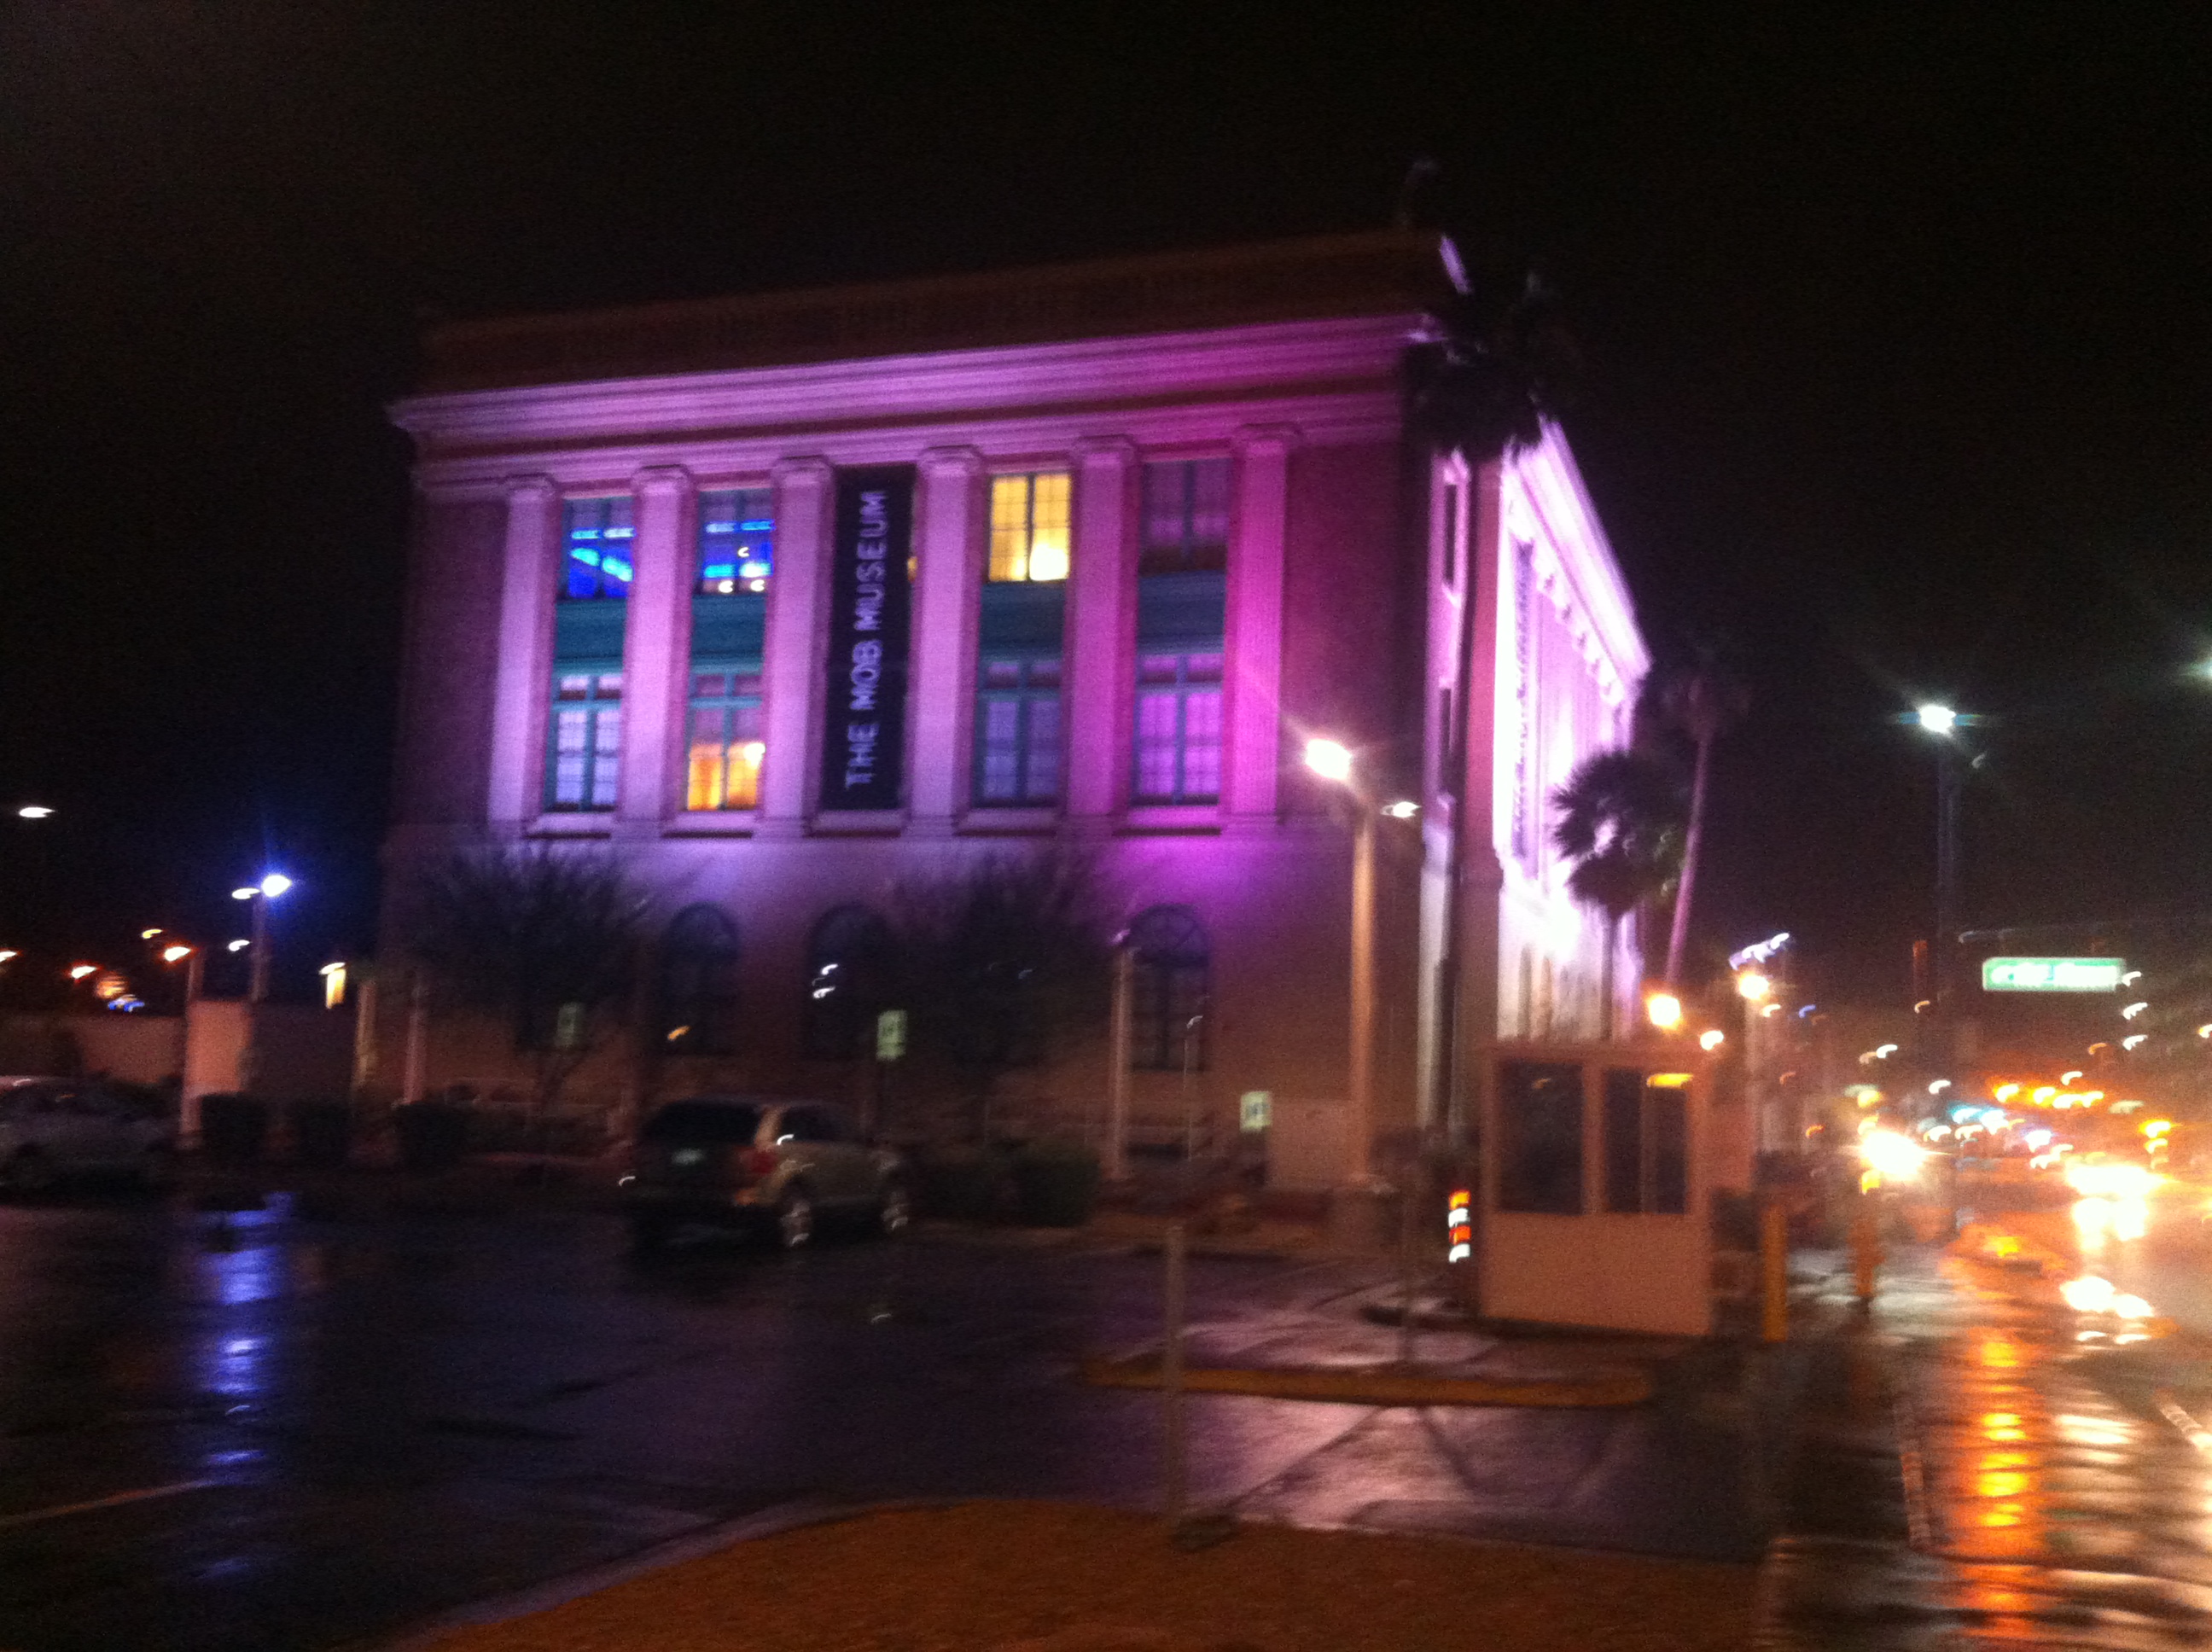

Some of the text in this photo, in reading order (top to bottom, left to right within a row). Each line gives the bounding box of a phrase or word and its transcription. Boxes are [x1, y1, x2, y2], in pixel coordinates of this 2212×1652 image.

[845, 491, 888, 788] THE MOB MUSEUM
